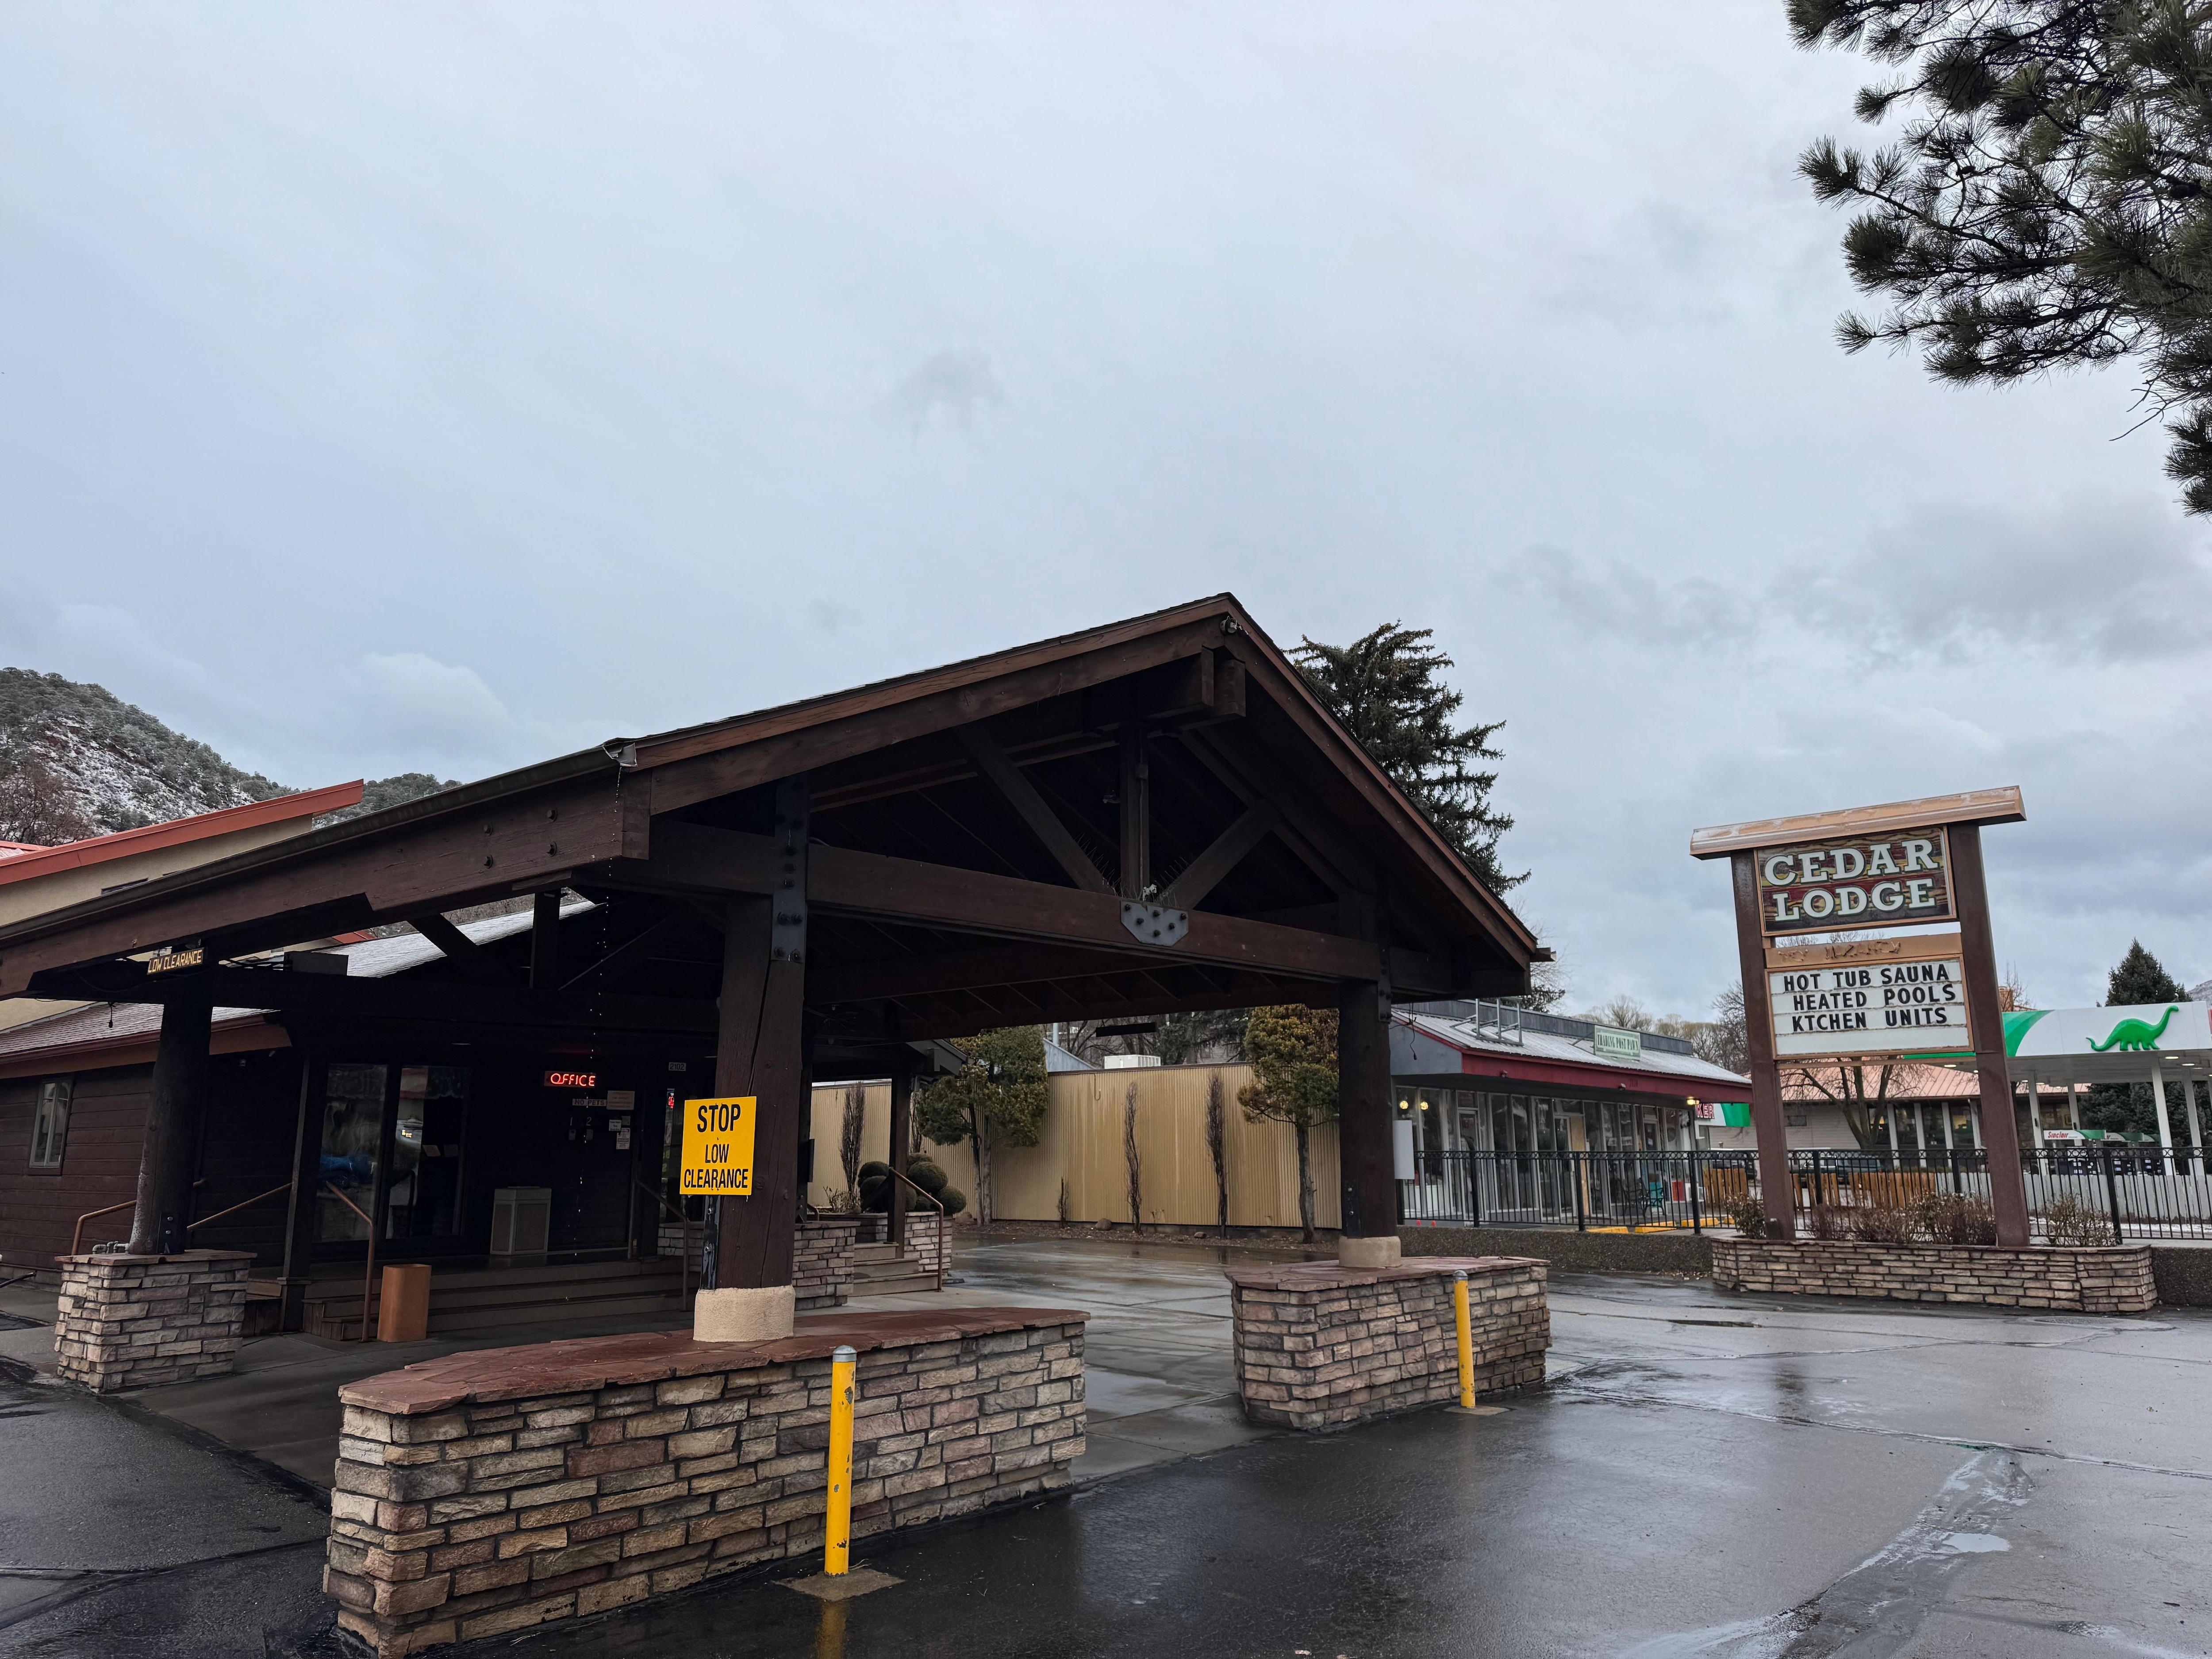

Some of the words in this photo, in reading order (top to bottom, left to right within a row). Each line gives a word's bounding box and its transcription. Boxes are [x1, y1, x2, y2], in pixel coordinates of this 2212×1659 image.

[1764, 839, 1939, 886] CEDAR
[1773, 878, 1936, 921] LODGE
[148, 957, 163, 973] LOW
[164, 949, 203, 970] CLEARANCE
[1784, 973, 1820, 991] HOT
[1832, 970, 1871, 988] TUB
[1880, 964, 1949, 985] SAUNA
[1793, 991, 1867, 1011] HEATED
[1884, 984, 1956, 1006] POOLS
[1792, 1012, 1867, 1032] KTCHEN
[1885, 1007, 1947, 1027] UNITS
[1598, 1034, 1615, 1048] TRADING
[1616, 1037, 1626, 1049] POST
[550, 1073, 596, 1087] OFFICE
[586, 1116, 592, 1126] 2
[697, 1104, 741, 1133] STOP
[705, 1143, 730, 1164] LOW
[684, 1168, 749, 1189] CLEARANCE
